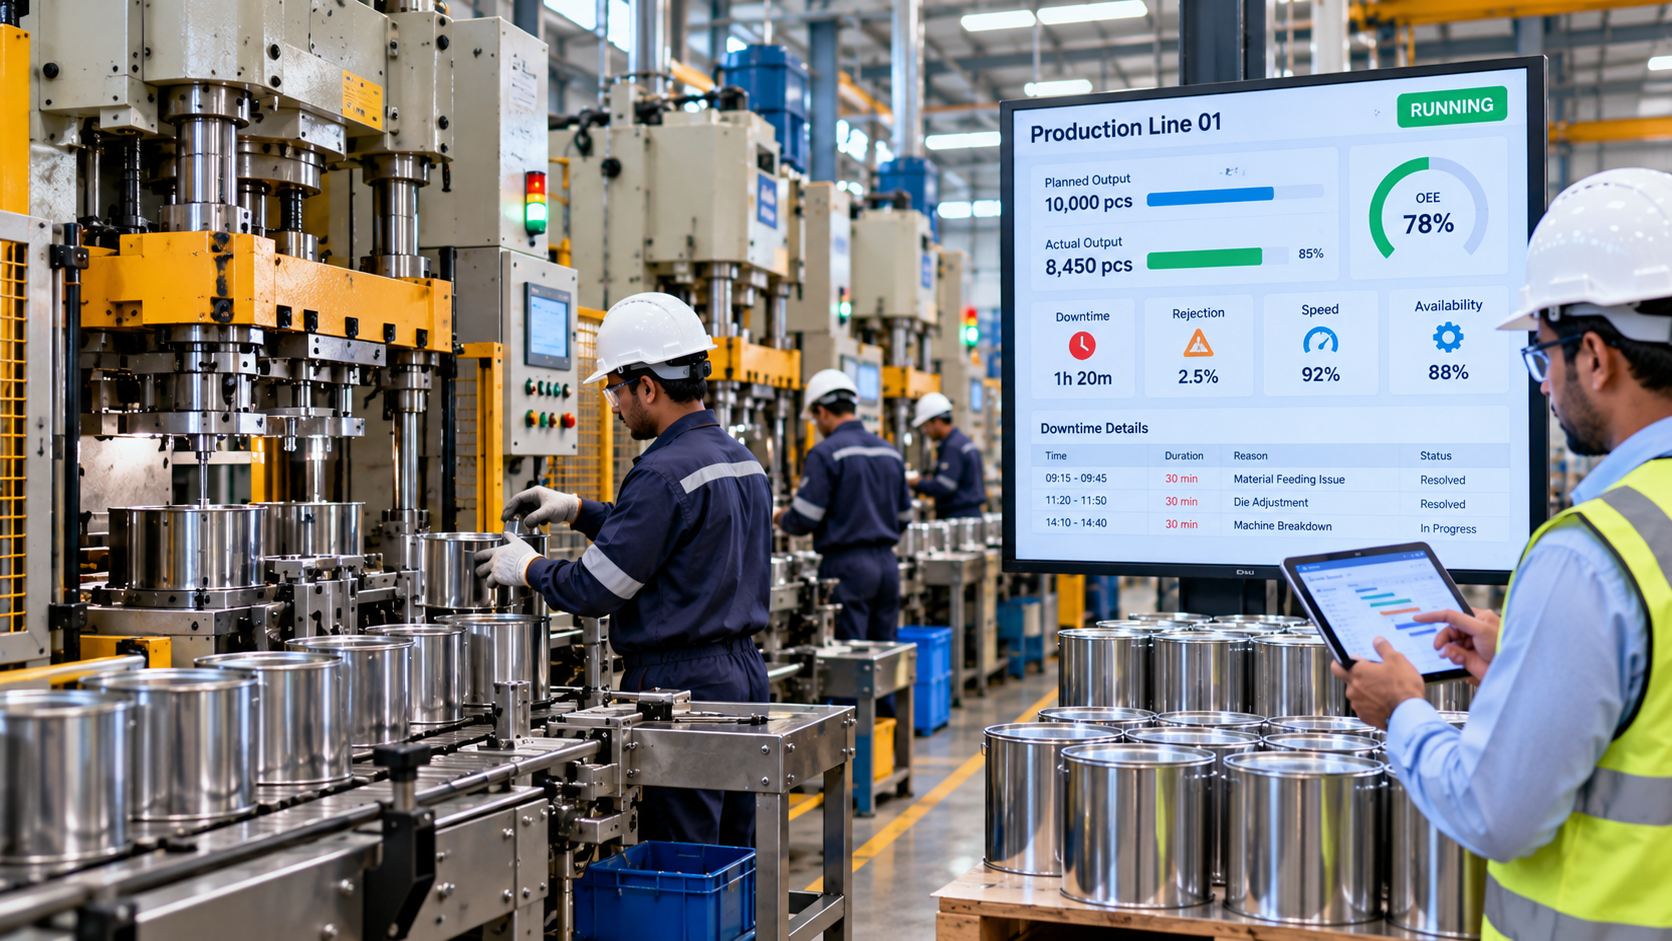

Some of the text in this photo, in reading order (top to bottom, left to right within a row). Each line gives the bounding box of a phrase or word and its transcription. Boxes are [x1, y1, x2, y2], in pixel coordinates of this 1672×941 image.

[1411, 97, 1493, 117] RUNNING
[1031, 112, 1220, 143] Production Line 01
[1045, 174, 1130, 188] Planned Output
[1416, 192, 1440, 203] OEE
[1045, 195, 1132, 214] 10,000 pcs
[1404, 213, 1454, 234] 78%
[1045, 237, 1122, 250] Actual Output
[1299, 248, 1324, 259] 85%
[1046, 257, 1133, 277] 8,450 pcs
[1302, 304, 1339, 317] Speed
[1415, 299, 1483, 312] Availability
[1056, 311, 1110, 322] Downtime
[1173, 308, 1224, 321] Rejection
[1055, 371, 1111, 385] 1h 20m
[1179, 369, 1218, 384] 2.5%
[1302, 367, 1340, 382] 92%
[1429, 364, 1469, 380] 88%
[1041, 422, 1148, 434] Downtime Details
[1045, 451, 1067, 460] Time
[1165, 451, 1203, 460] Duration
[1234, 451, 1267, 460] Reason
[1421, 451, 1452, 460] Status
[1046, 473, 1071, 482] 09:15
[1081, 473, 1107, 483] 09:45
[1166, 474, 1198, 483] 30 min
[1234, 474, 1345, 486] Material Feeding Issue
[1421, 475, 1465, 485] Resolved
[1046, 496, 1071, 505] 11:20
[1081, 496, 1107, 505] 11:50
[1166, 497, 1198, 506] 30 min
[1234, 497, 1308, 509] Die Adjustment
[1421, 499, 1465, 509] Resolved
[1046, 518, 1071, 527] 14:10
[1081, 518, 1107, 527] 14:40
[1166, 519, 1198, 528] 30 min
[1234, 521, 1332, 531] Machine Breakdown
[1421, 524, 1476, 536] In Progress
